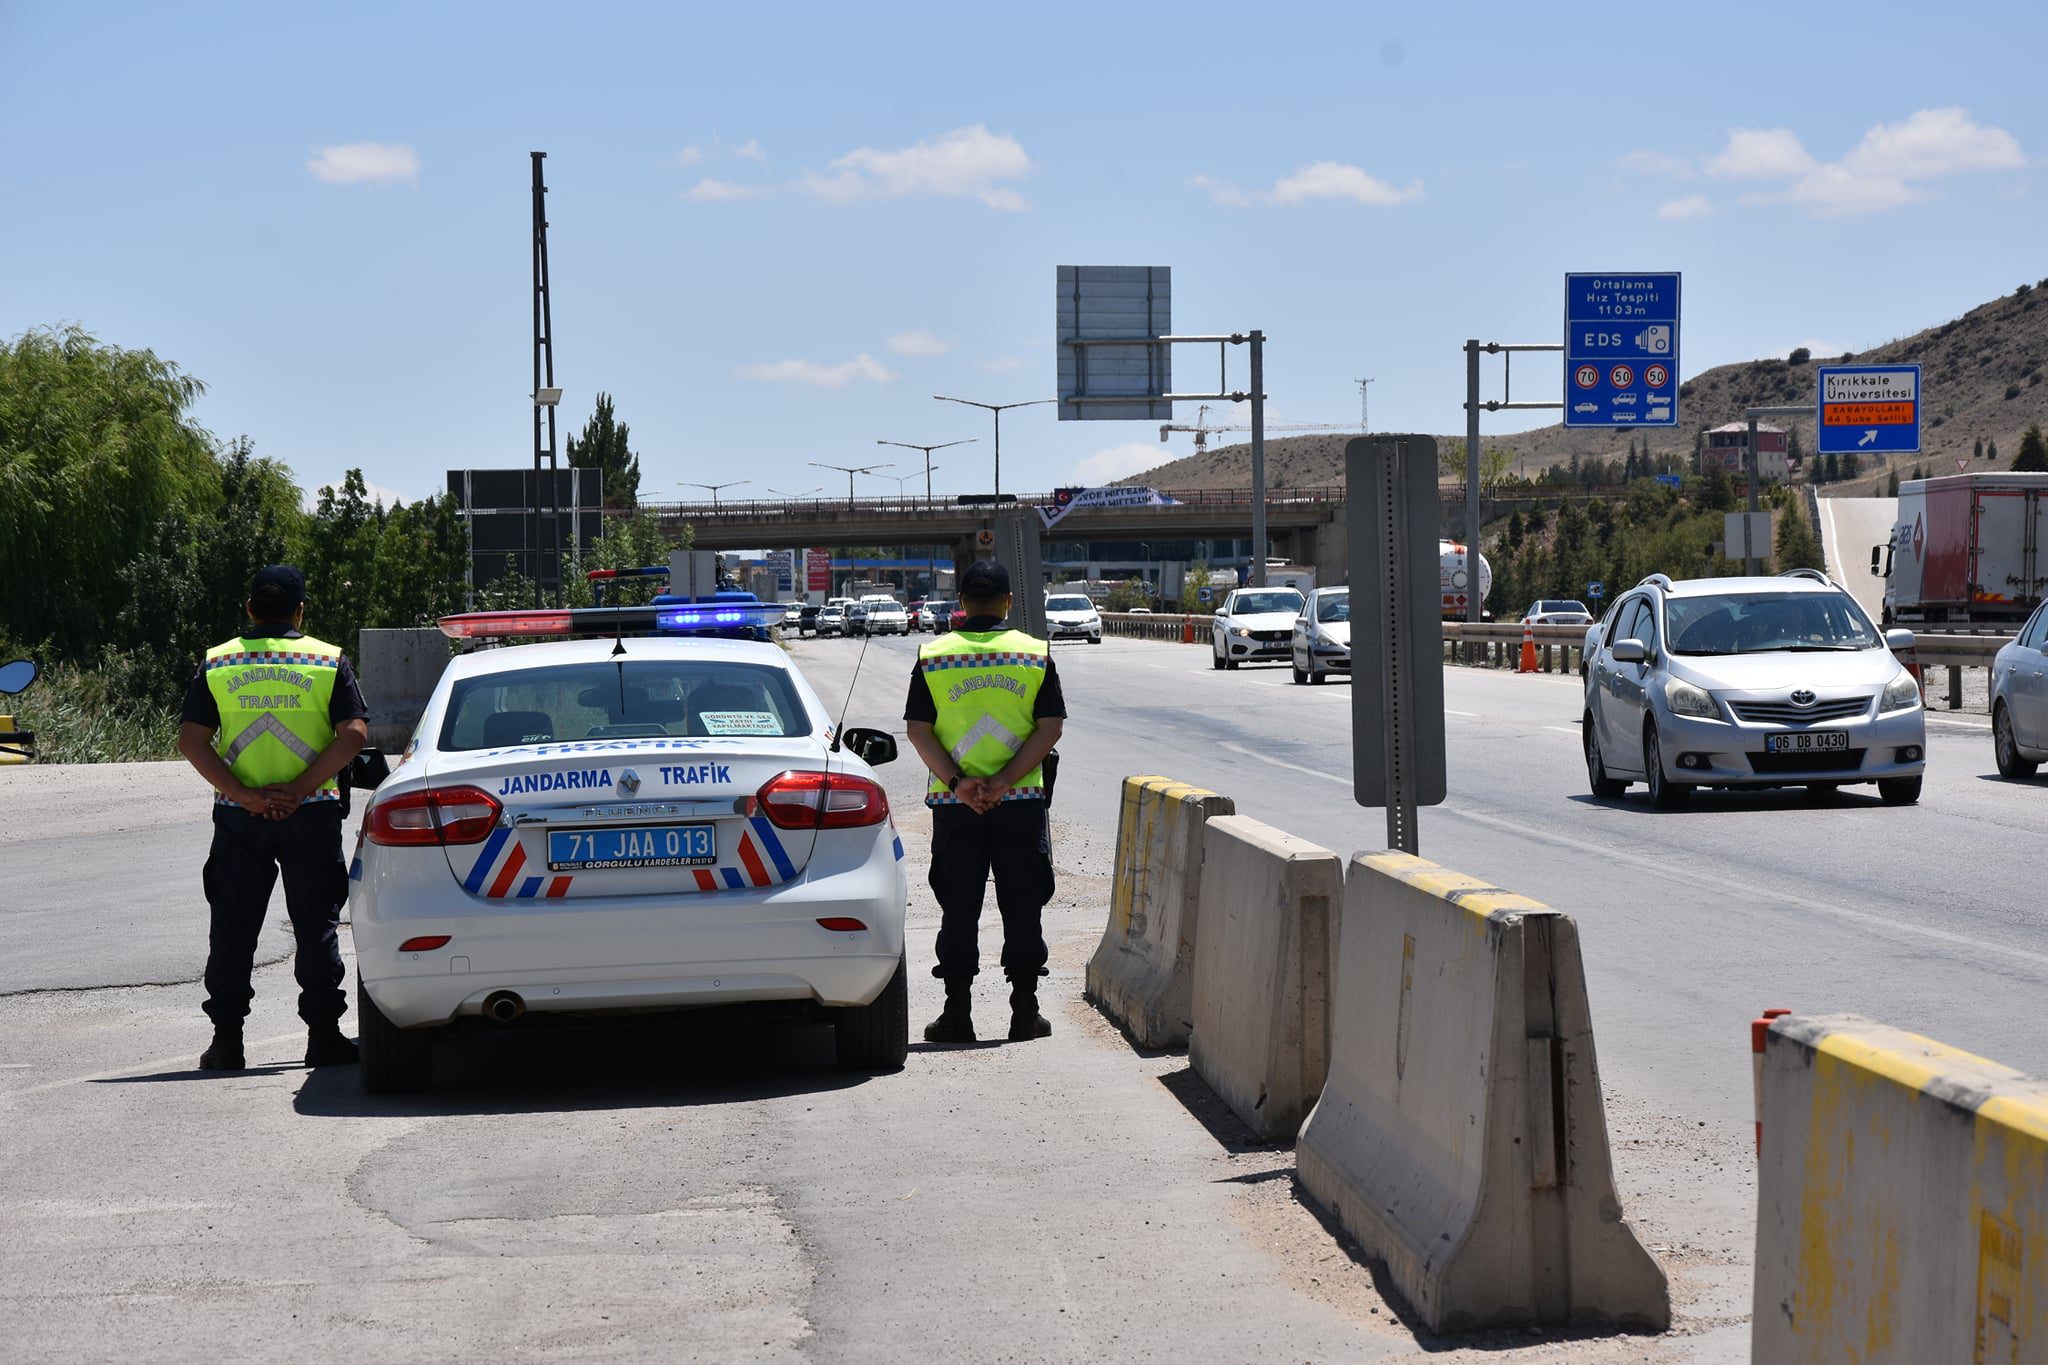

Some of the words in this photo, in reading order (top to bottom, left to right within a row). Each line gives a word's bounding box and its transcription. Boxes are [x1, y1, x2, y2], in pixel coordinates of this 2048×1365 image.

[1593, 280, 1654, 289] Ortalama
[1586, 293, 1608, 302] Hız
[1614, 293, 1659, 304] Tespiti
[1584, 333, 1622, 347] EDS
[1580, 371, 1595, 382] 70
[1615, 371, 1630, 382] 50
[1649, 371, 1664, 382] 50
[1827, 387, 1911, 399] Üniversitesi
[1832, 405, 1905, 414] KARAYOLLARI
[226, 667, 314, 694] JANDARMA
[948, 674, 1027, 702] JANDARMA
[1775, 735, 1790, 749] 06
[1797, 734, 1812, 748] DB
[1817, 733, 1845, 747] 0430
[498, 769, 613, 796] JANDARMA
[659, 761, 732, 785] TRAFİK
[582, 805, 680, 818] FLUENCE
[569, 834, 595, 860] 71
[613, 831, 656, 858] JAA
[665, 830, 709, 856] 013
